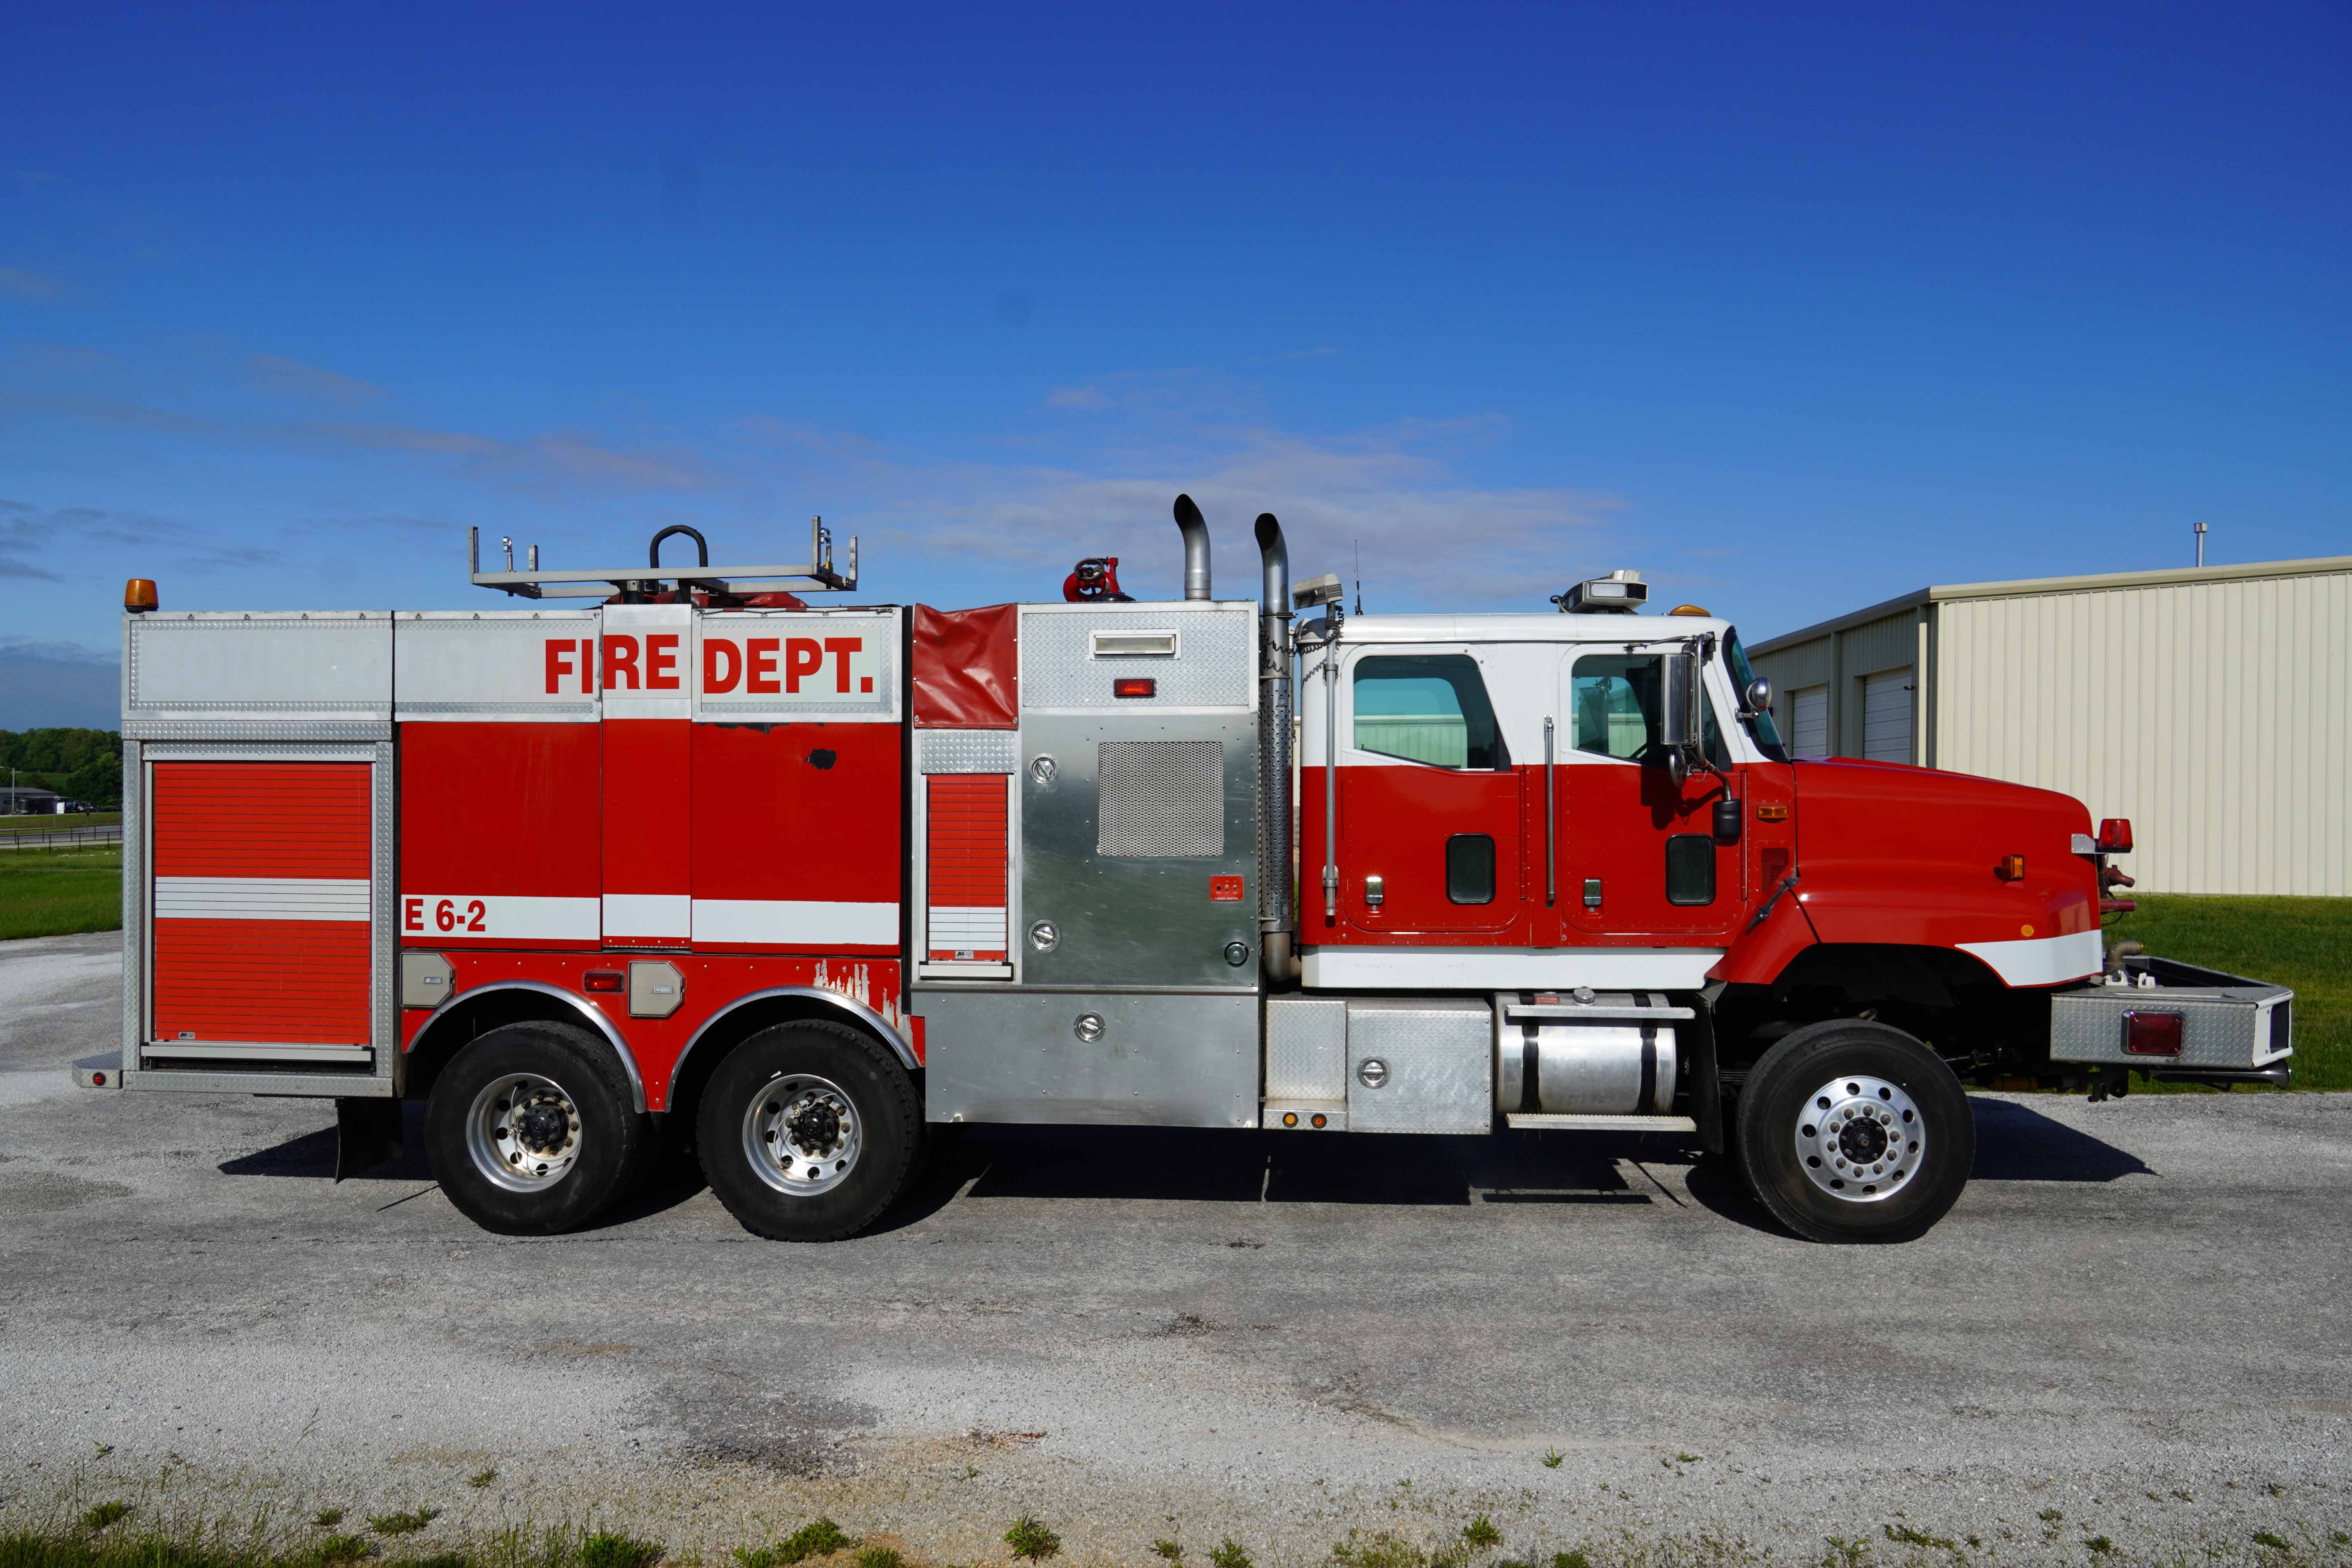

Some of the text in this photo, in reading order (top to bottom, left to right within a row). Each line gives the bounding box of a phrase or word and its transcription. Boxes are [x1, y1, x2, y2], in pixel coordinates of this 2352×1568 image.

[545, 634, 680, 694] FIRE
[703, 637, 873, 694] DEPT.
[405, 898, 486, 932] E 6-2
